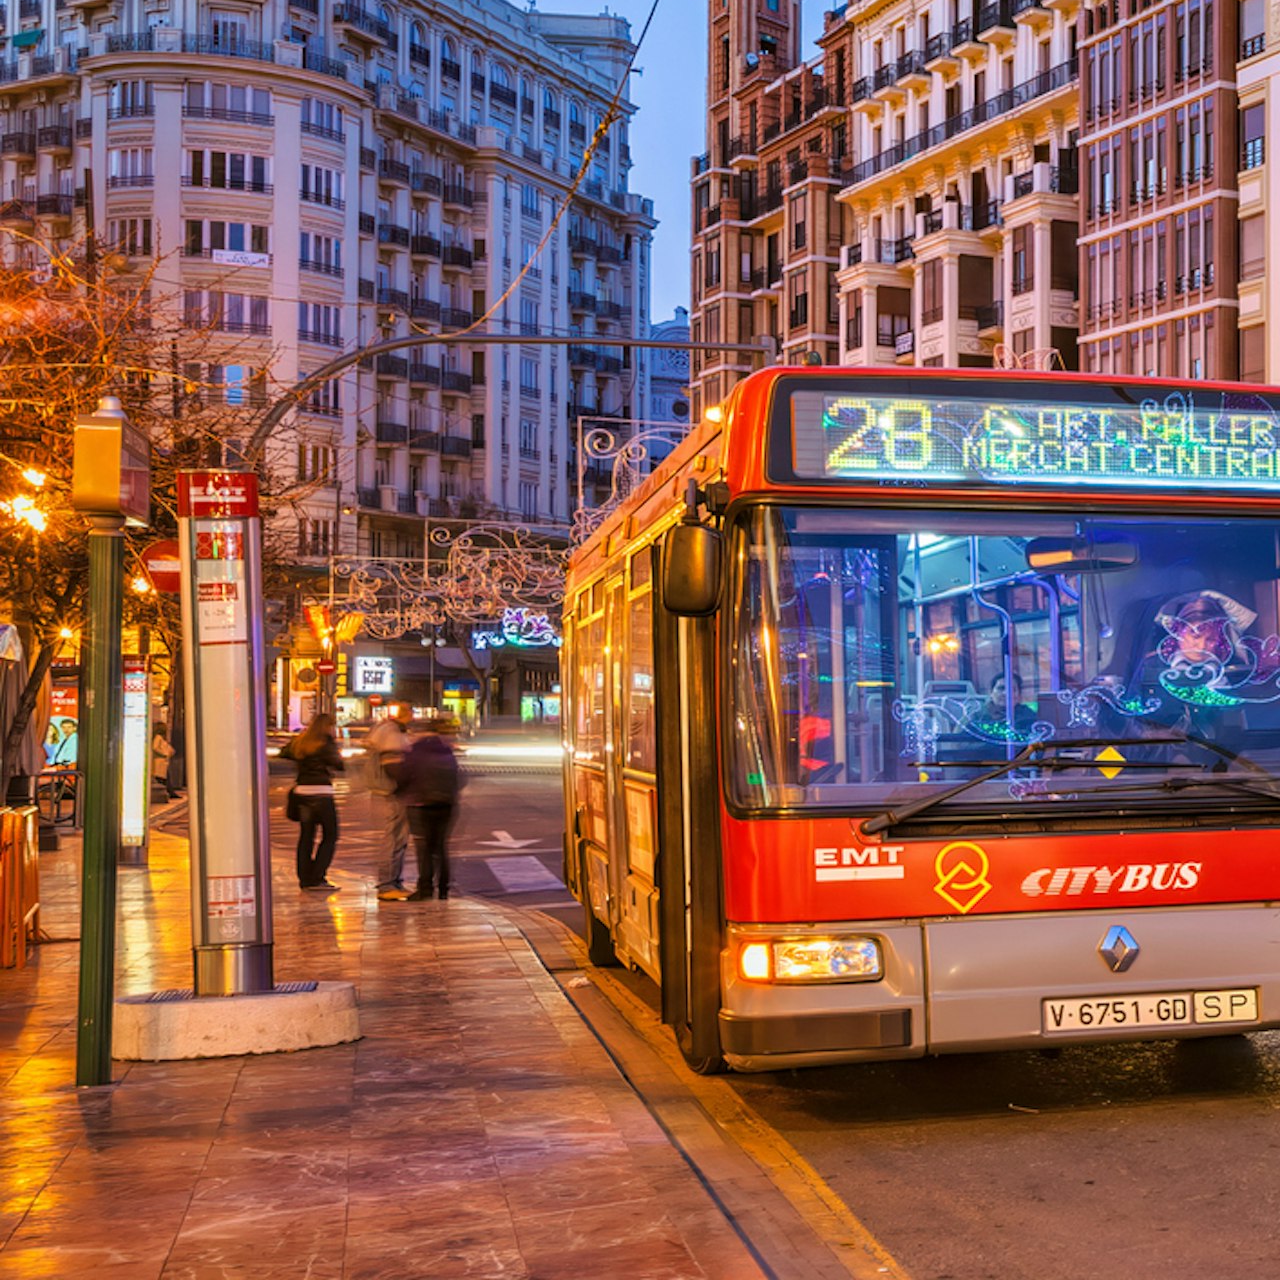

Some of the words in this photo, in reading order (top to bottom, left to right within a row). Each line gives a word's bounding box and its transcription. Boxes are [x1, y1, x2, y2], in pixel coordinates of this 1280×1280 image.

[827, 398, 932, 469] 28
[962, 437, 1114, 472] MERCAT
[815, 846, 904, 865] EMT
[1020, 862, 1202, 897] CITYBUS
